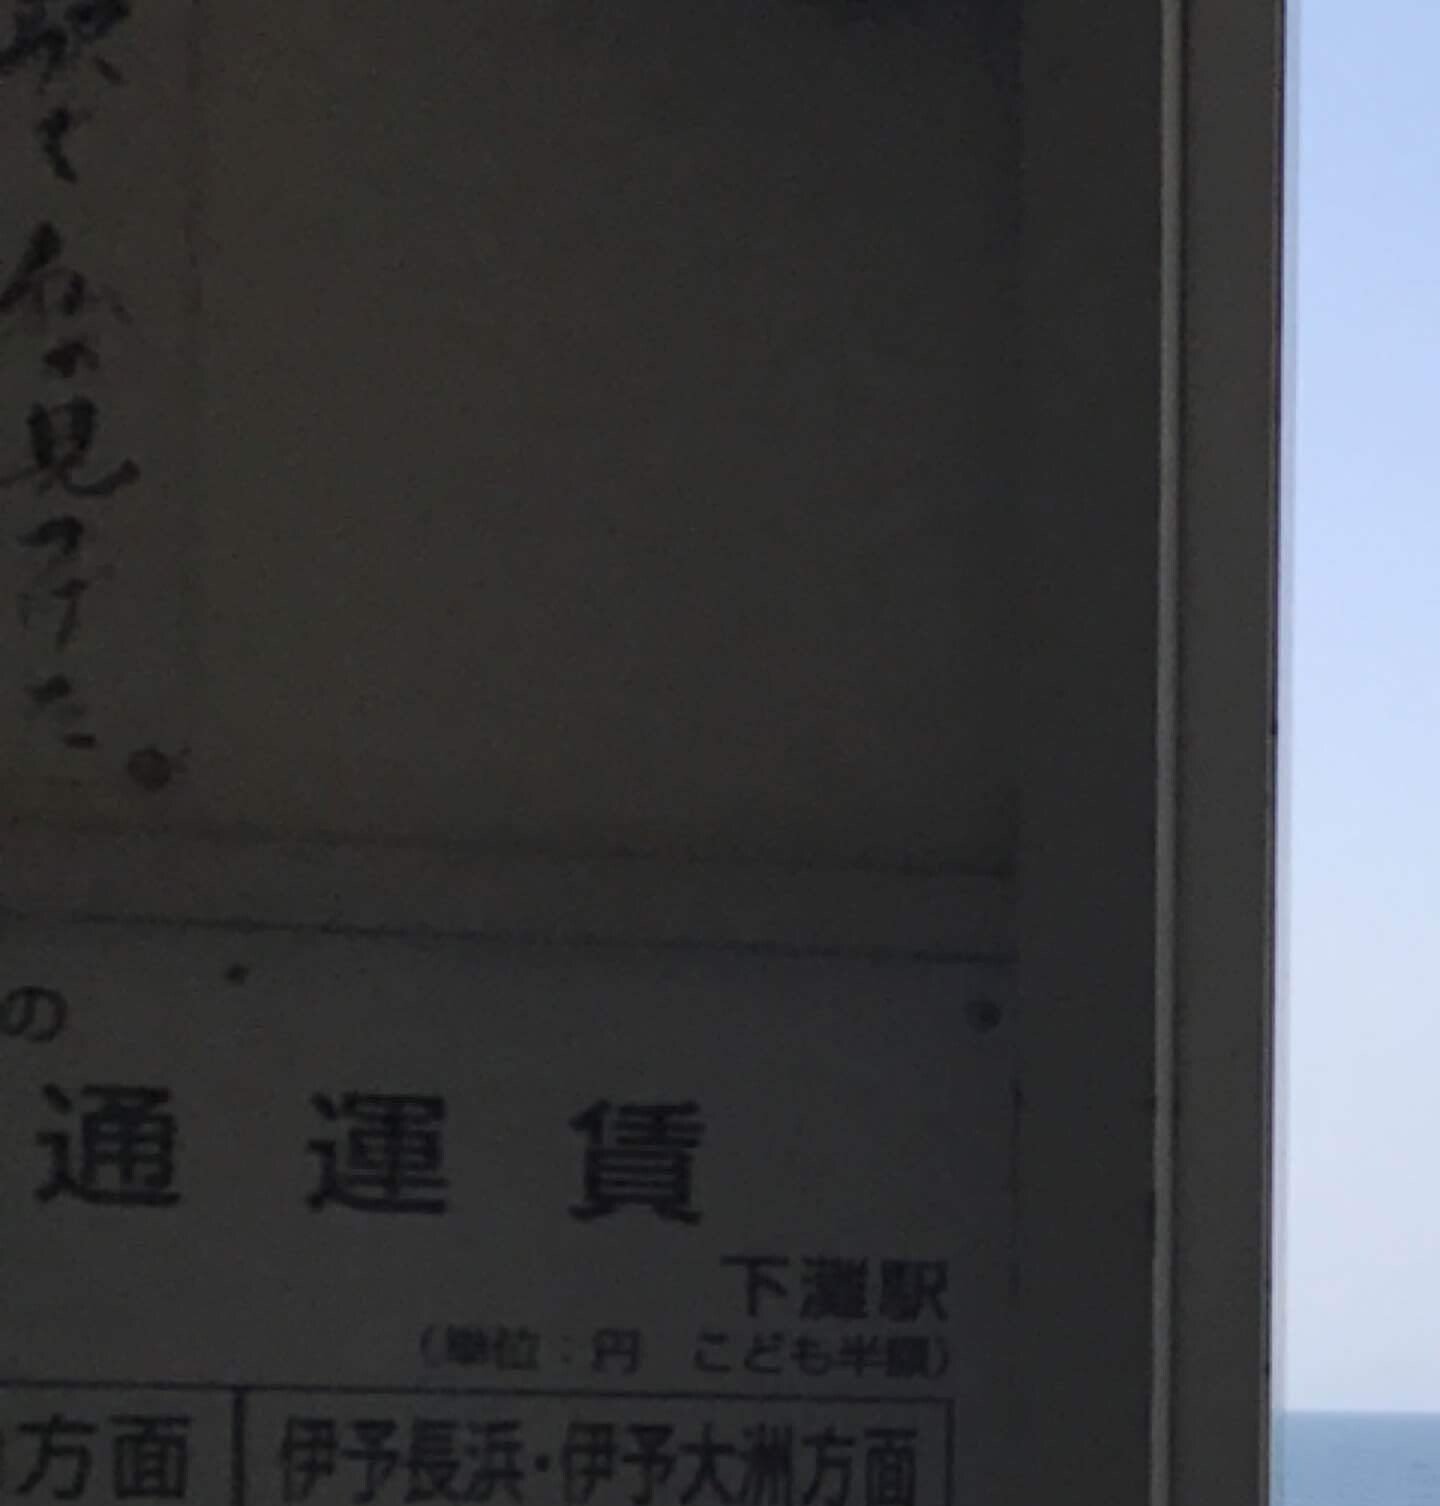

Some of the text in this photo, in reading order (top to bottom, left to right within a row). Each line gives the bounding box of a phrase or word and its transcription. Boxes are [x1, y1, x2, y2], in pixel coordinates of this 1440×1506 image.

[0, 985, 68, 1043] の
[722, 1255, 948, 1323] 下灘駅
